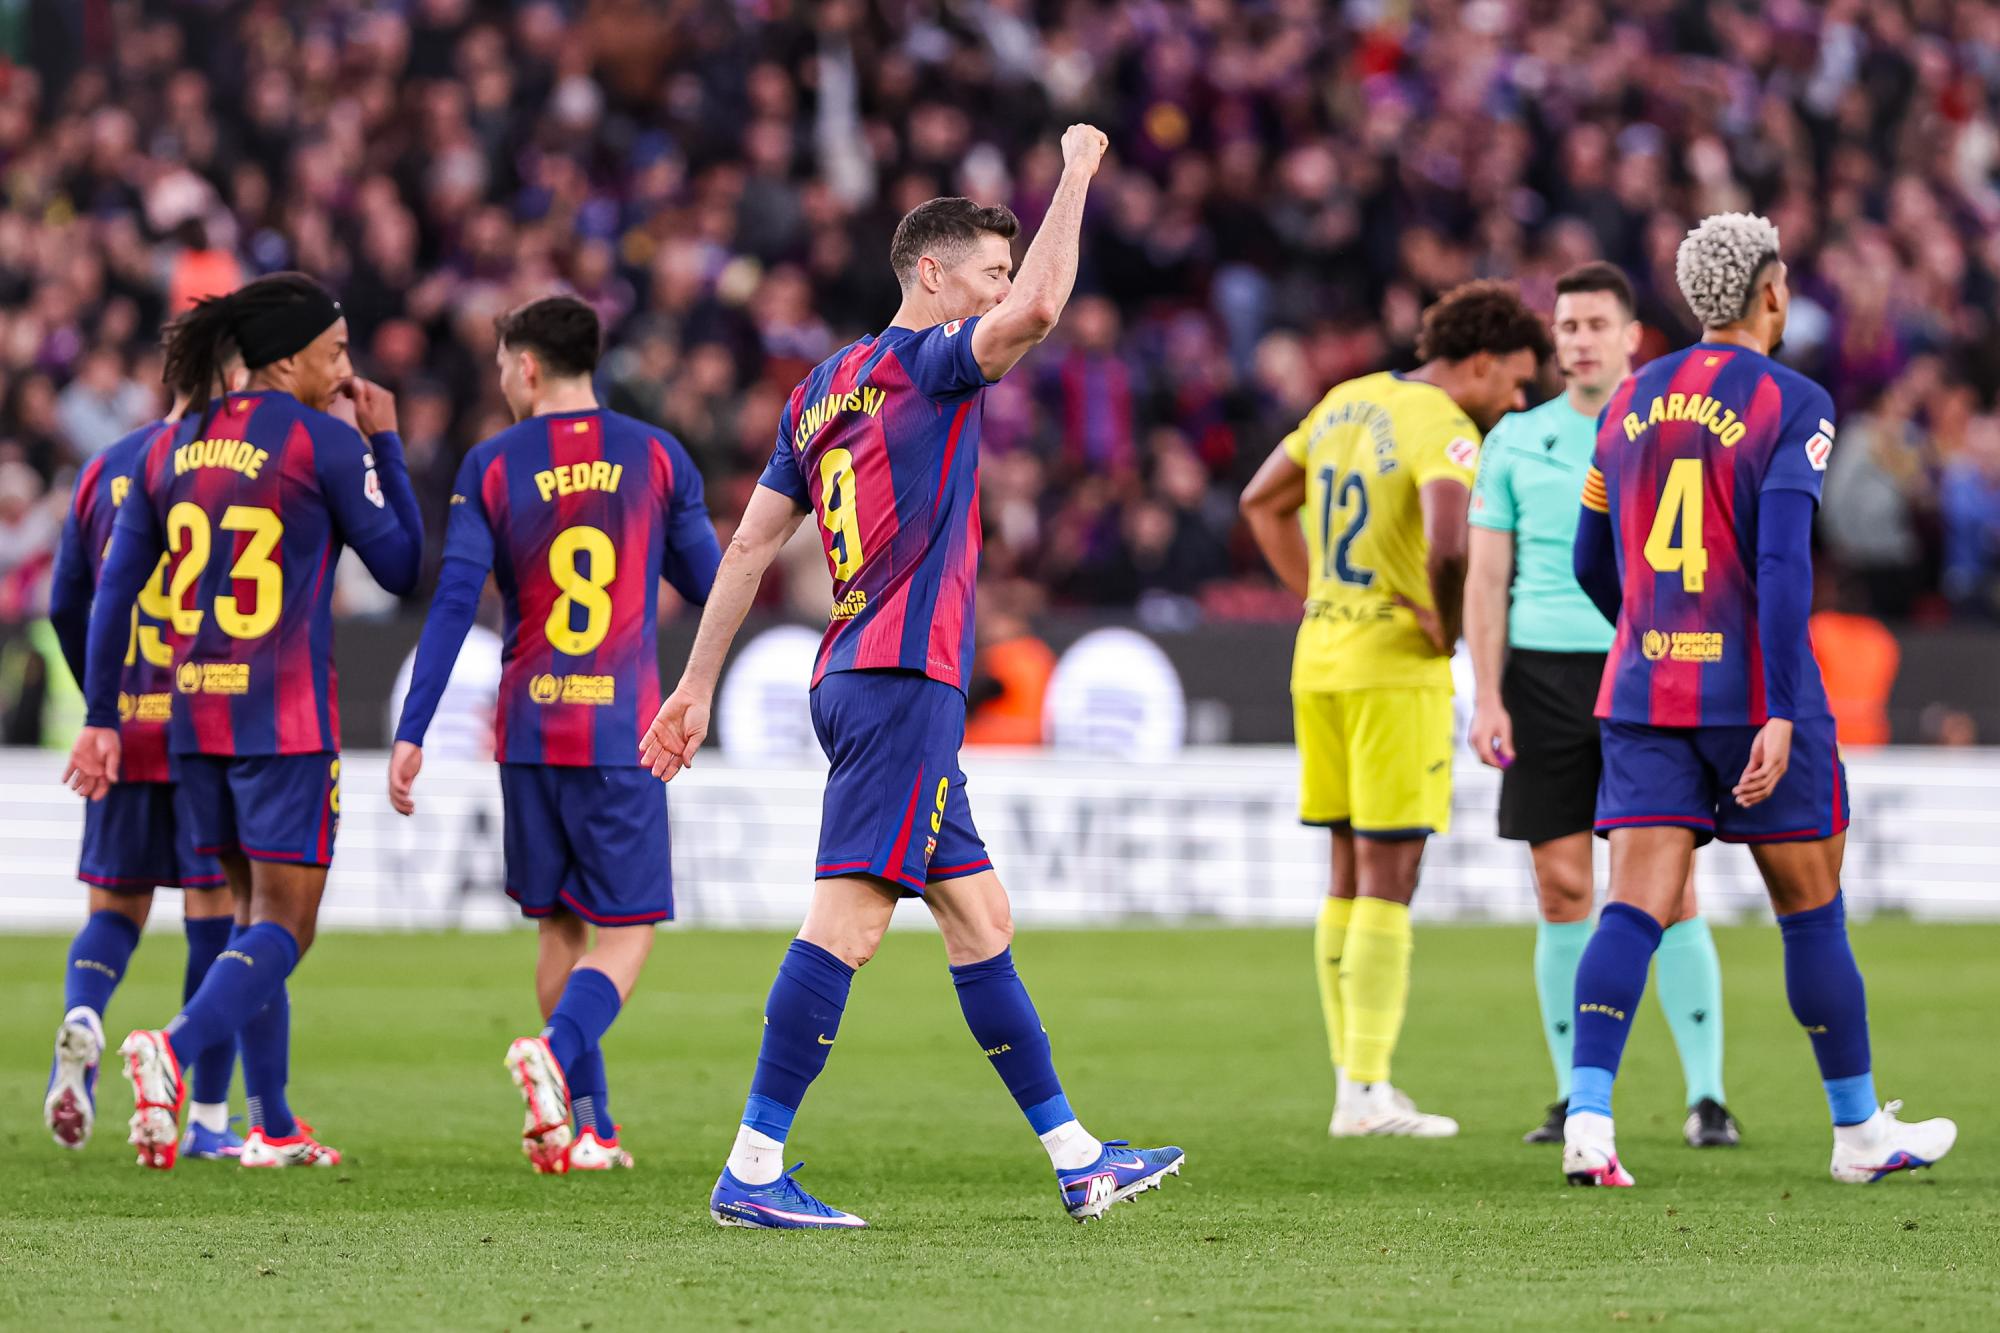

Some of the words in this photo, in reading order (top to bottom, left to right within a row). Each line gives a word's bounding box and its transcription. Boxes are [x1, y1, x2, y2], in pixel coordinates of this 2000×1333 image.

[174, 439, 270, 480] KOUNDE
[534, 460, 623, 502] PEDRI
[820, 448, 864, 582] 9
[166, 501, 284, 640] 23
[1317, 466, 1376, 587] 12
[1643, 458, 1708, 592] 4
[544, 525, 616, 656] 8
[930, 776, 949, 834] 9
